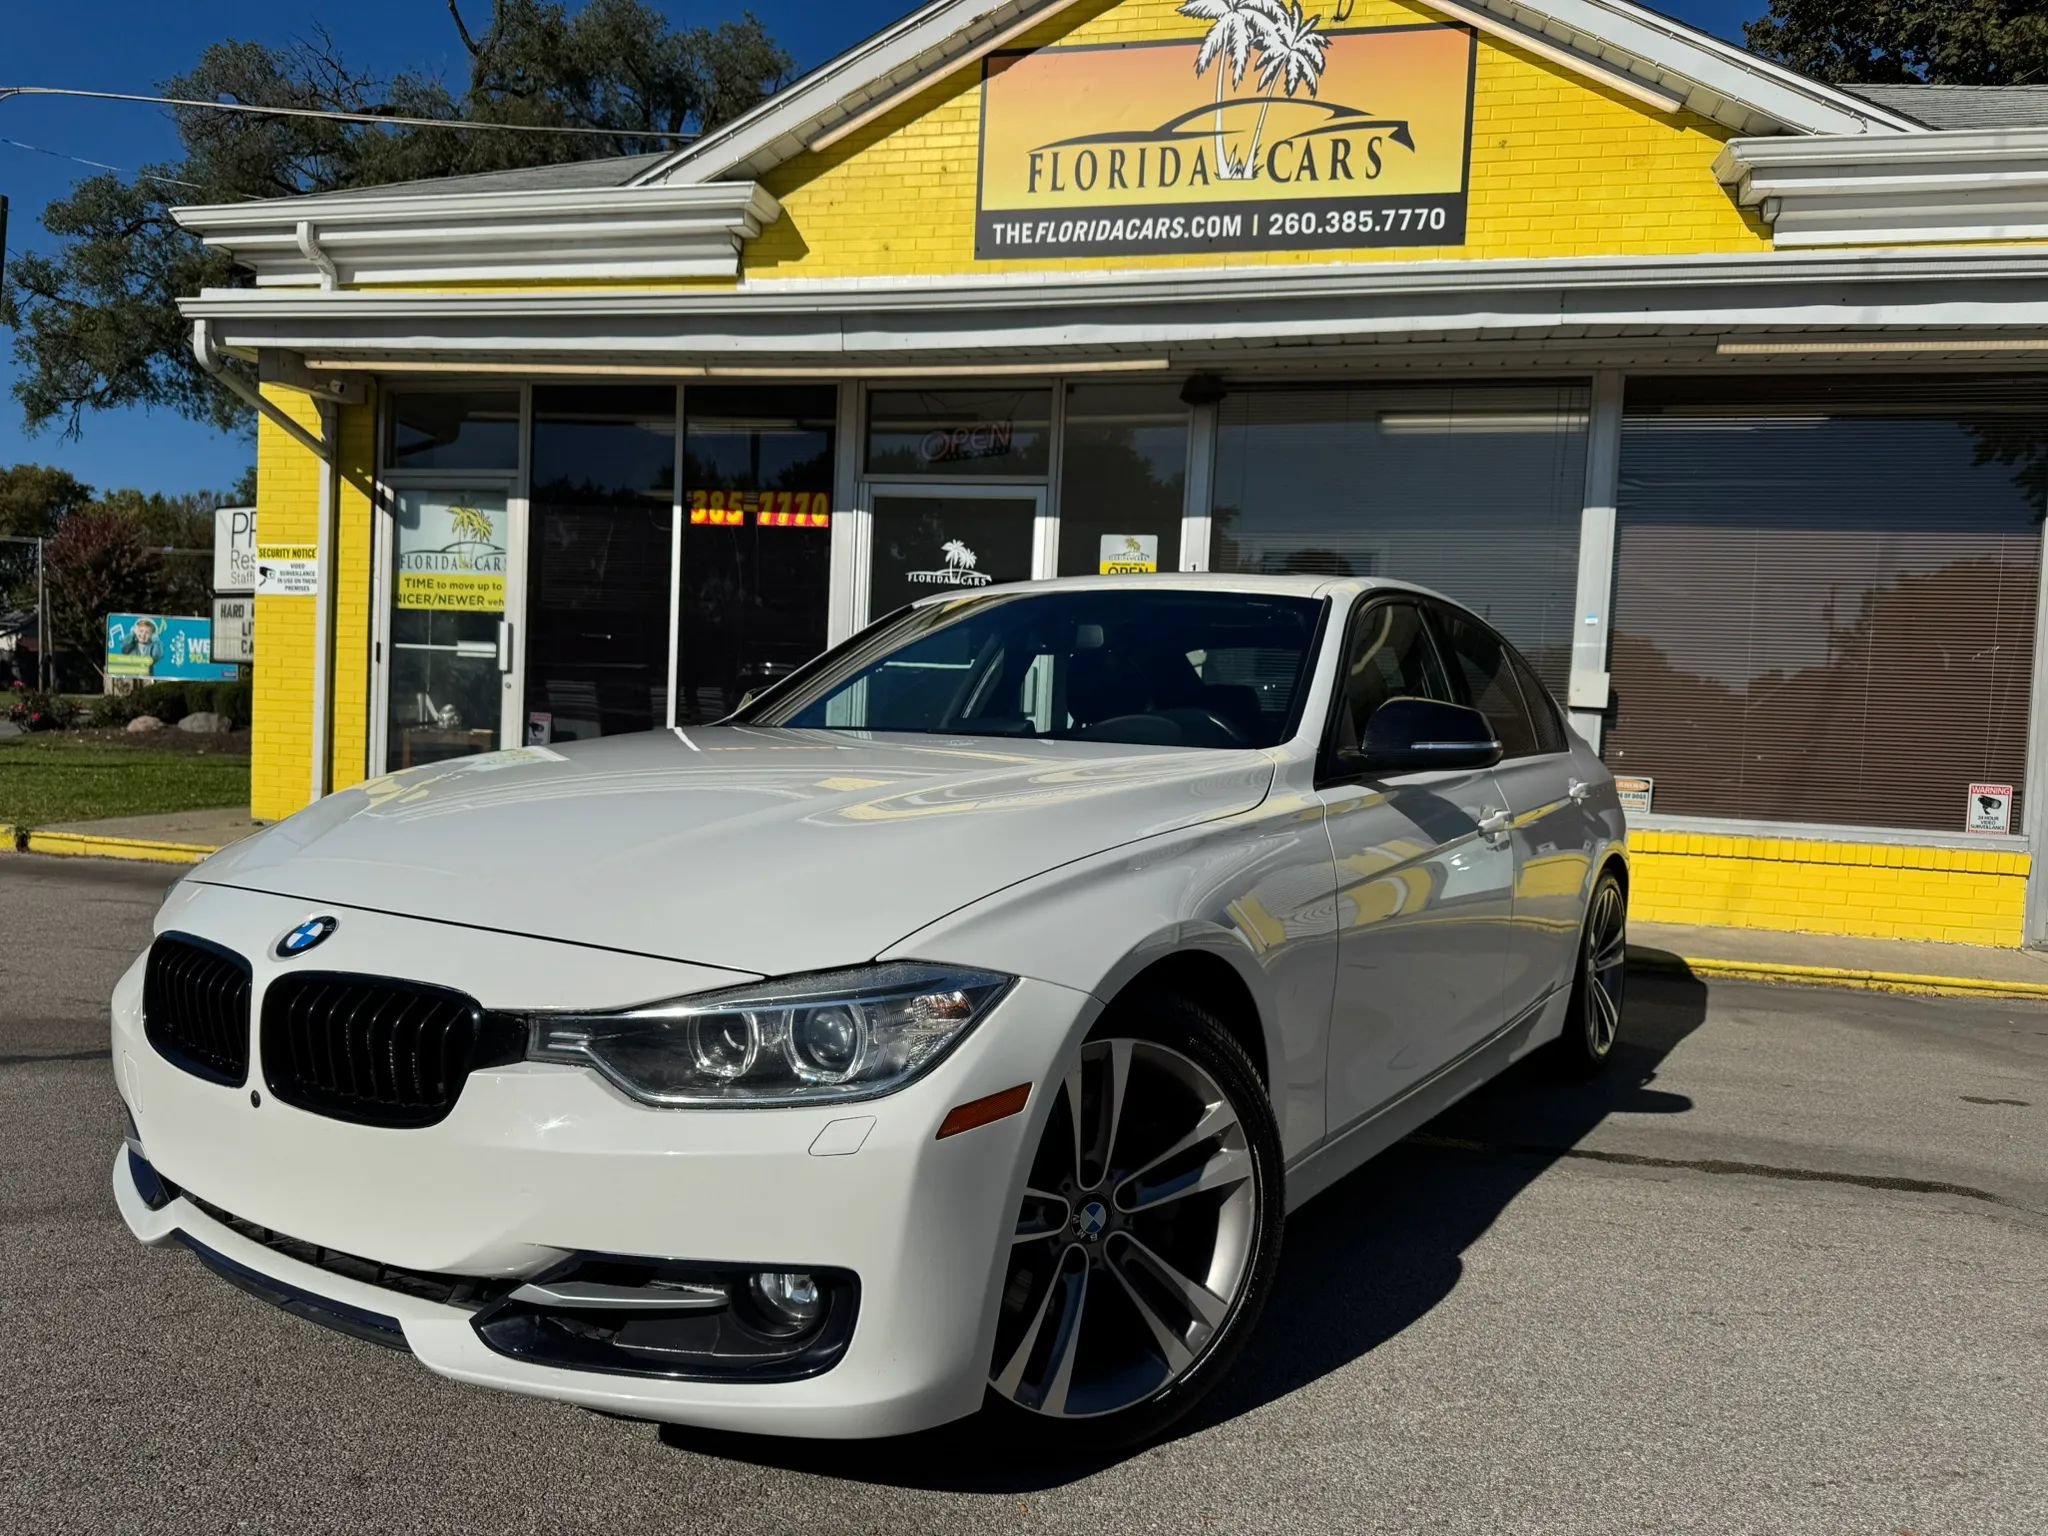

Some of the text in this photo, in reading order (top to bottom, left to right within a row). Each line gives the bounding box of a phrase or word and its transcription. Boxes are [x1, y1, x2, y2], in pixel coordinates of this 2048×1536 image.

[1028, 135, 1383, 193] FLORIDA CARS
[992, 214, 1242, 245] THEFLORIDACARS.COM
[1268, 207, 1447, 236] 260.385.7770
[921, 421, 1011, 461] OPEN
[691, 490, 829, 526] 385-7770
[259, 547, 317, 559] SECURITY NOTICE
[400, 554, 459, 570] FLORIDA
[404, 578, 502, 592] TIME to move up to
[907, 573, 987, 587] FLORIDA CARS
[220, 604, 245, 618] HARD
[1972, 785, 2009, 795] WARNING
